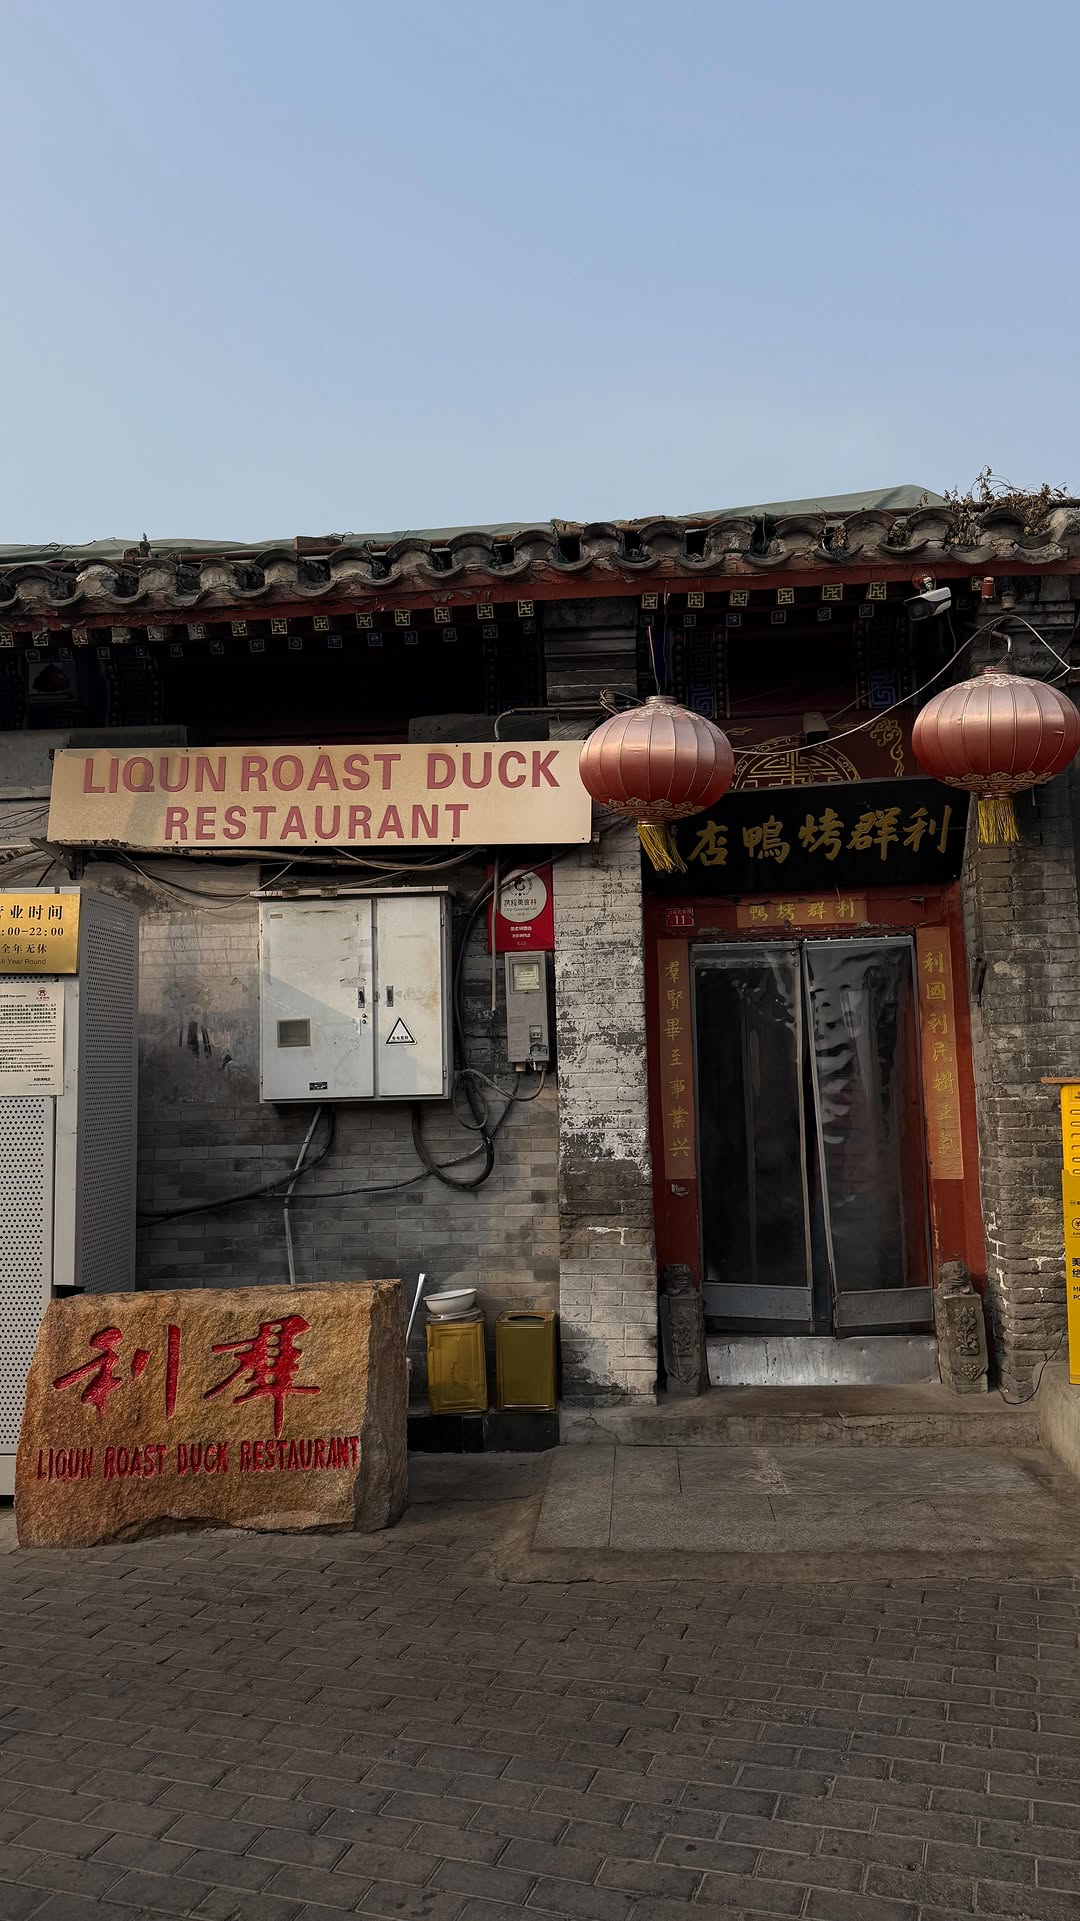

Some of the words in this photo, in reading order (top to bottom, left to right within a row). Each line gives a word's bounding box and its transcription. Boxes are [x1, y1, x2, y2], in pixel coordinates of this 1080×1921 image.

[83, 757, 228, 794] LIQUN
[241, 752, 401, 792] ROAST
[427, 750, 560, 789] DUCK
[164, 803, 469, 841] RESTAURANT
[675, 915, 685, 925] 11
[1, 944, 47, 955] 全年无休
[104, 1444, 168, 1479] ROAST
[178, 1442, 230, 1476] DUCK
[239, 1436, 360, 1473] RESTAURANT
